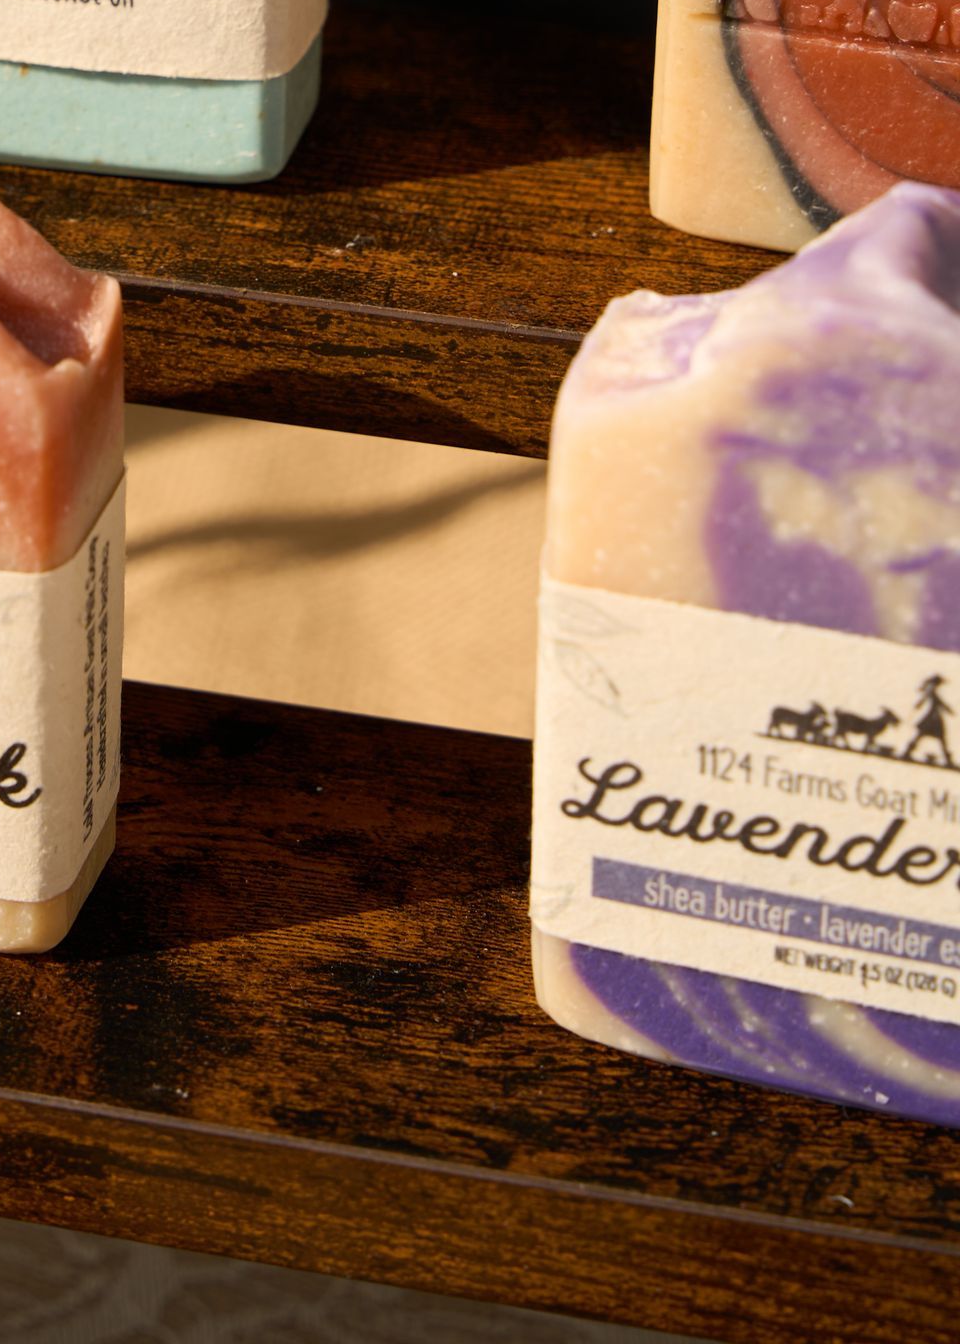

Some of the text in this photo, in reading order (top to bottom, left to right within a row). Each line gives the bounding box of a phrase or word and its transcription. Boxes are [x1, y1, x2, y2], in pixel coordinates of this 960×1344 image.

[697, 744, 753, 784] 1124
[763, 755, 848, 803] Farms
[855, 773, 918, 817] Goat
[644, 873, 706, 916] shea
[714, 885, 795, 933] butter
[820, 905, 932, 959] lavender
[774, 945, 802, 965] NET
